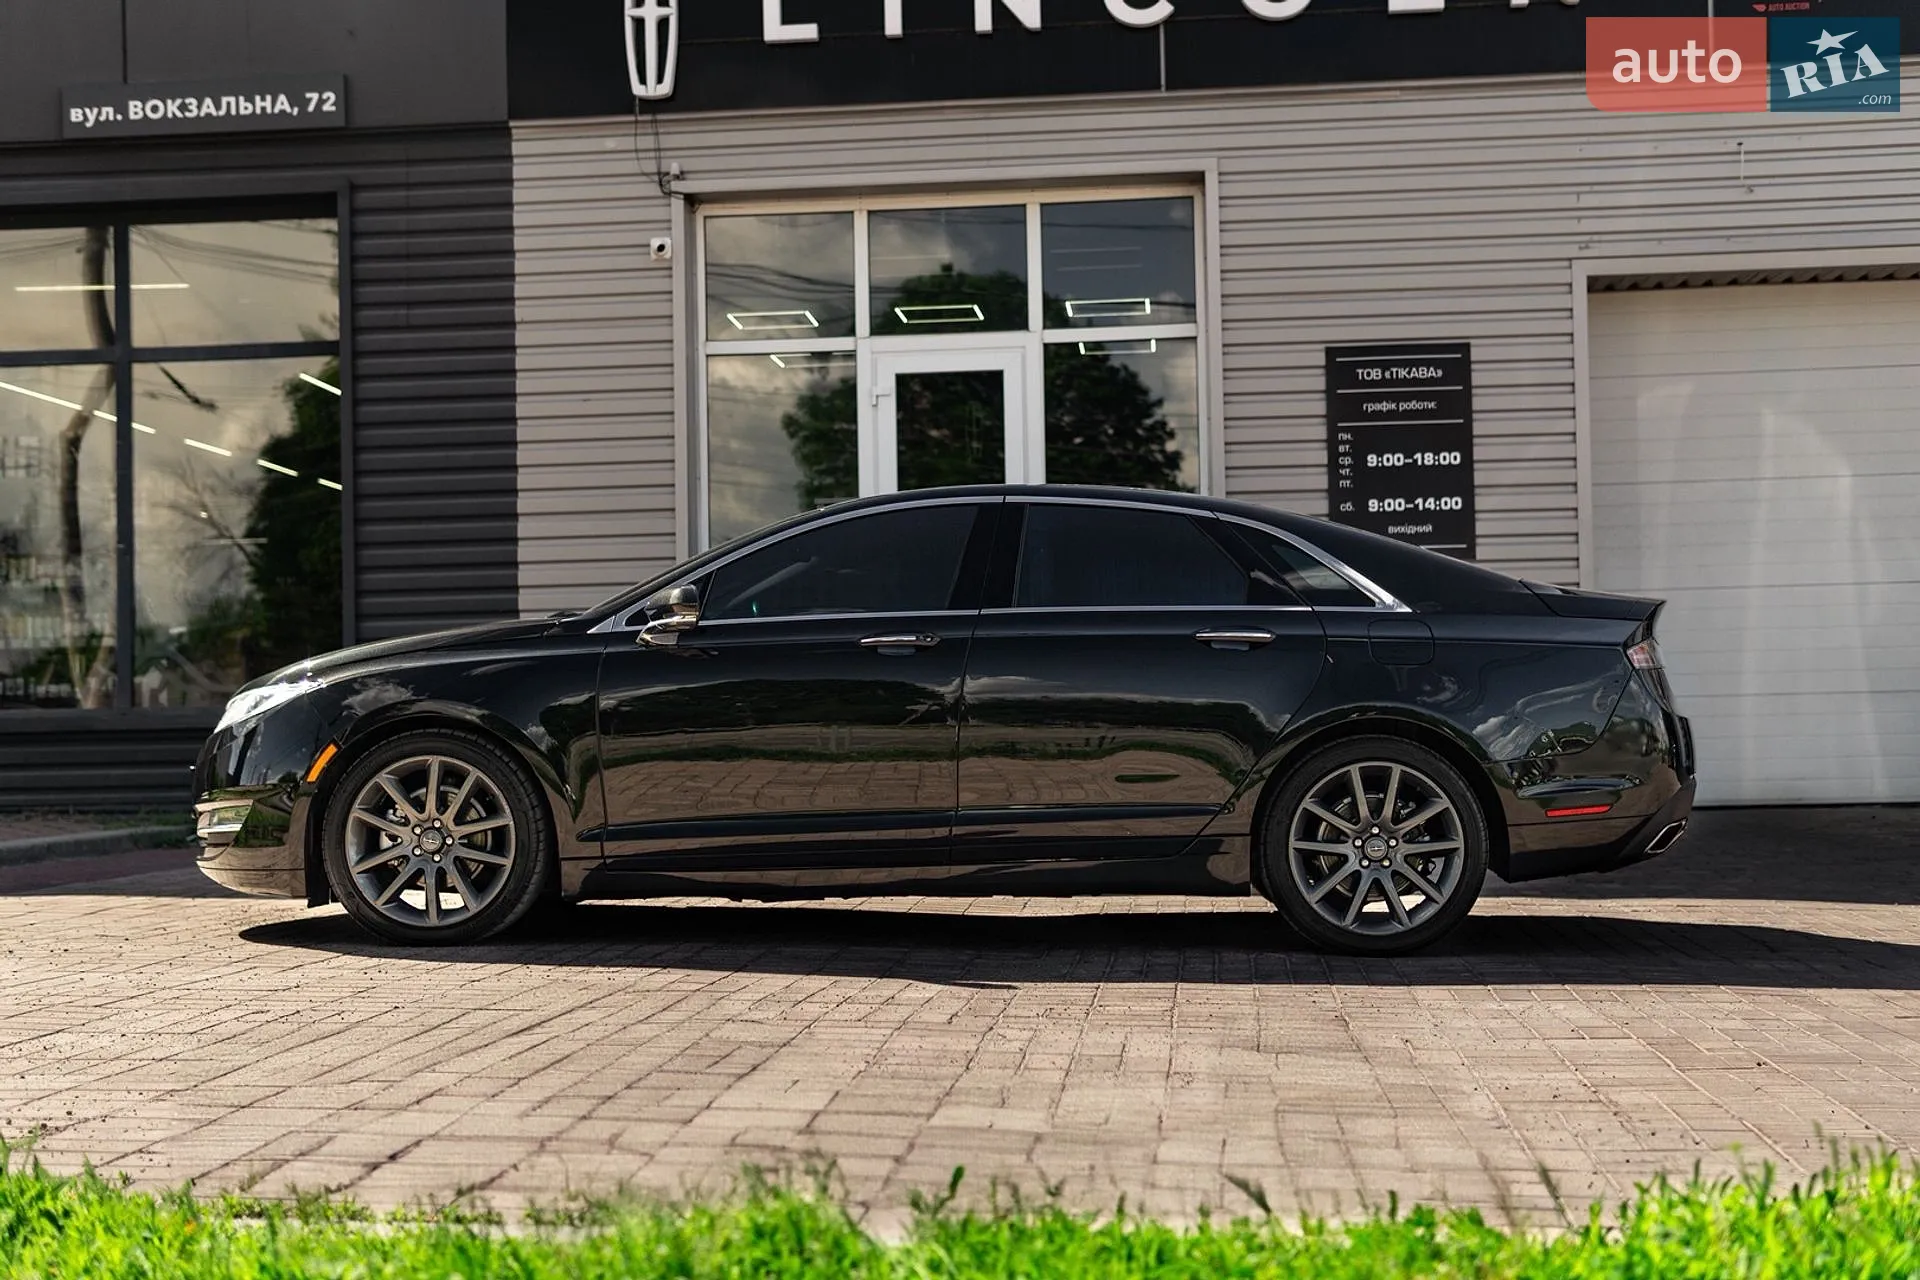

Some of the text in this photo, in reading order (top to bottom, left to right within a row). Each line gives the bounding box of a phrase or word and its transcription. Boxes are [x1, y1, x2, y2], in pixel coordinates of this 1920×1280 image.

[69, 91, 337, 128] вул. ВОКЗАЛЬНА, 72
[1355, 366, 1443, 381] ТОВ «ТІКАВА»
[1362, 400, 1437, 413] графік роботи:
[1338, 432, 1354, 441] пн.
[1338, 444, 1353, 453] вт.
[1338, 456, 1354, 466] ср.
[1339, 468, 1353, 476] чт.
[1339, 479, 1354, 488] пт.
[1340, 501, 1355, 512] сб.
[1387, 523, 1433, 535] вихідний
